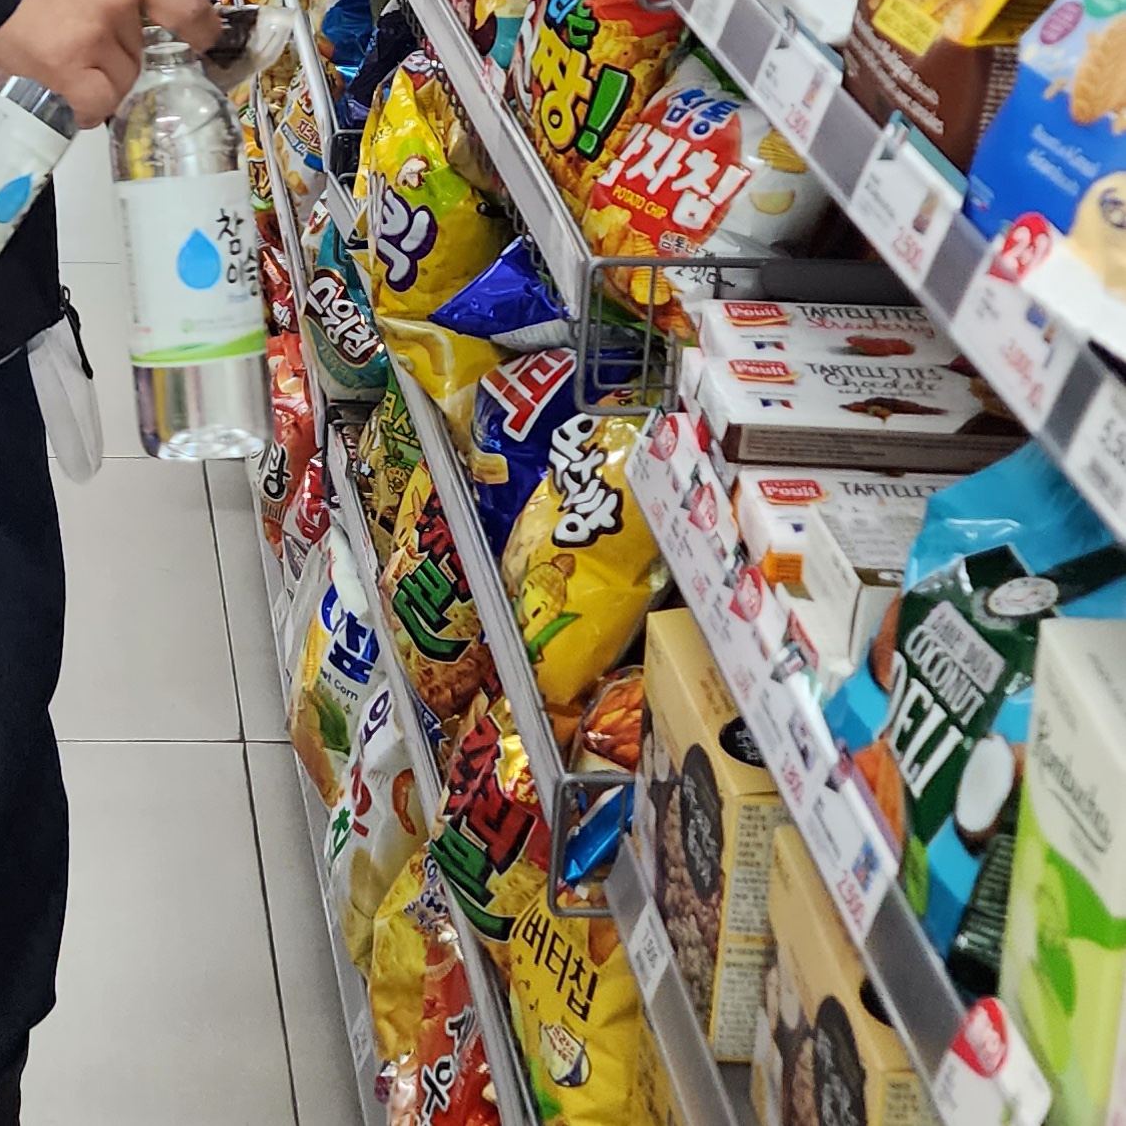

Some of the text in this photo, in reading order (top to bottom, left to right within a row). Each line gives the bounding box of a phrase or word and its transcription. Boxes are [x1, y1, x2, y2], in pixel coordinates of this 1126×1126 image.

[661, 87, 742, 137] 심통
[612, 184, 669, 221] POTATO CHIP
[306, 276, 380, 359] 스윙칩
[731, 306, 785, 320] Poult
[734, 362, 785, 377] Poult
[762, 480, 821, 500] Poult
[905, 624, 986, 727] COCONUT
[877, 650, 965, 800] DELI
[514, 899, 599, 1023] 버터칩
